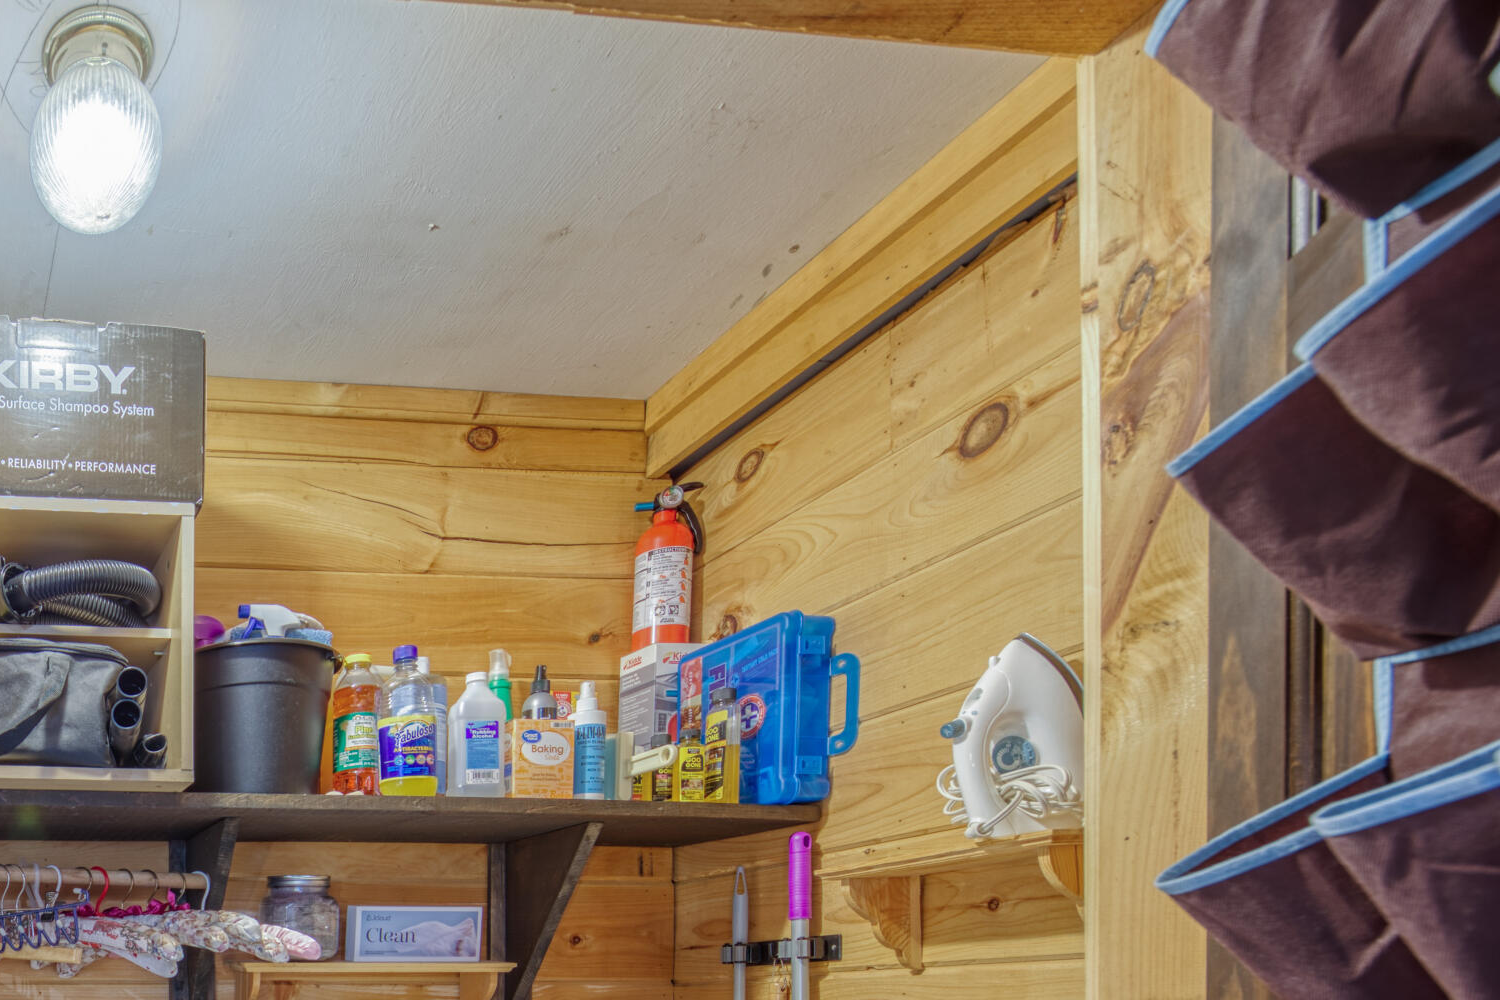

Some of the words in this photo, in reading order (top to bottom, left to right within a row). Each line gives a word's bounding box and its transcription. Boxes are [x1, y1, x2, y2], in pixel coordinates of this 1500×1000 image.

[49, 397, 109, 416] Shampoo
[112, 401, 155, 418] System
[8, 457, 67, 470] RELIABILITY
[74, 460, 157, 475] PERFORMANCE
[531, 744, 564, 755] Baking
[366, 927, 417, 943] Clean
